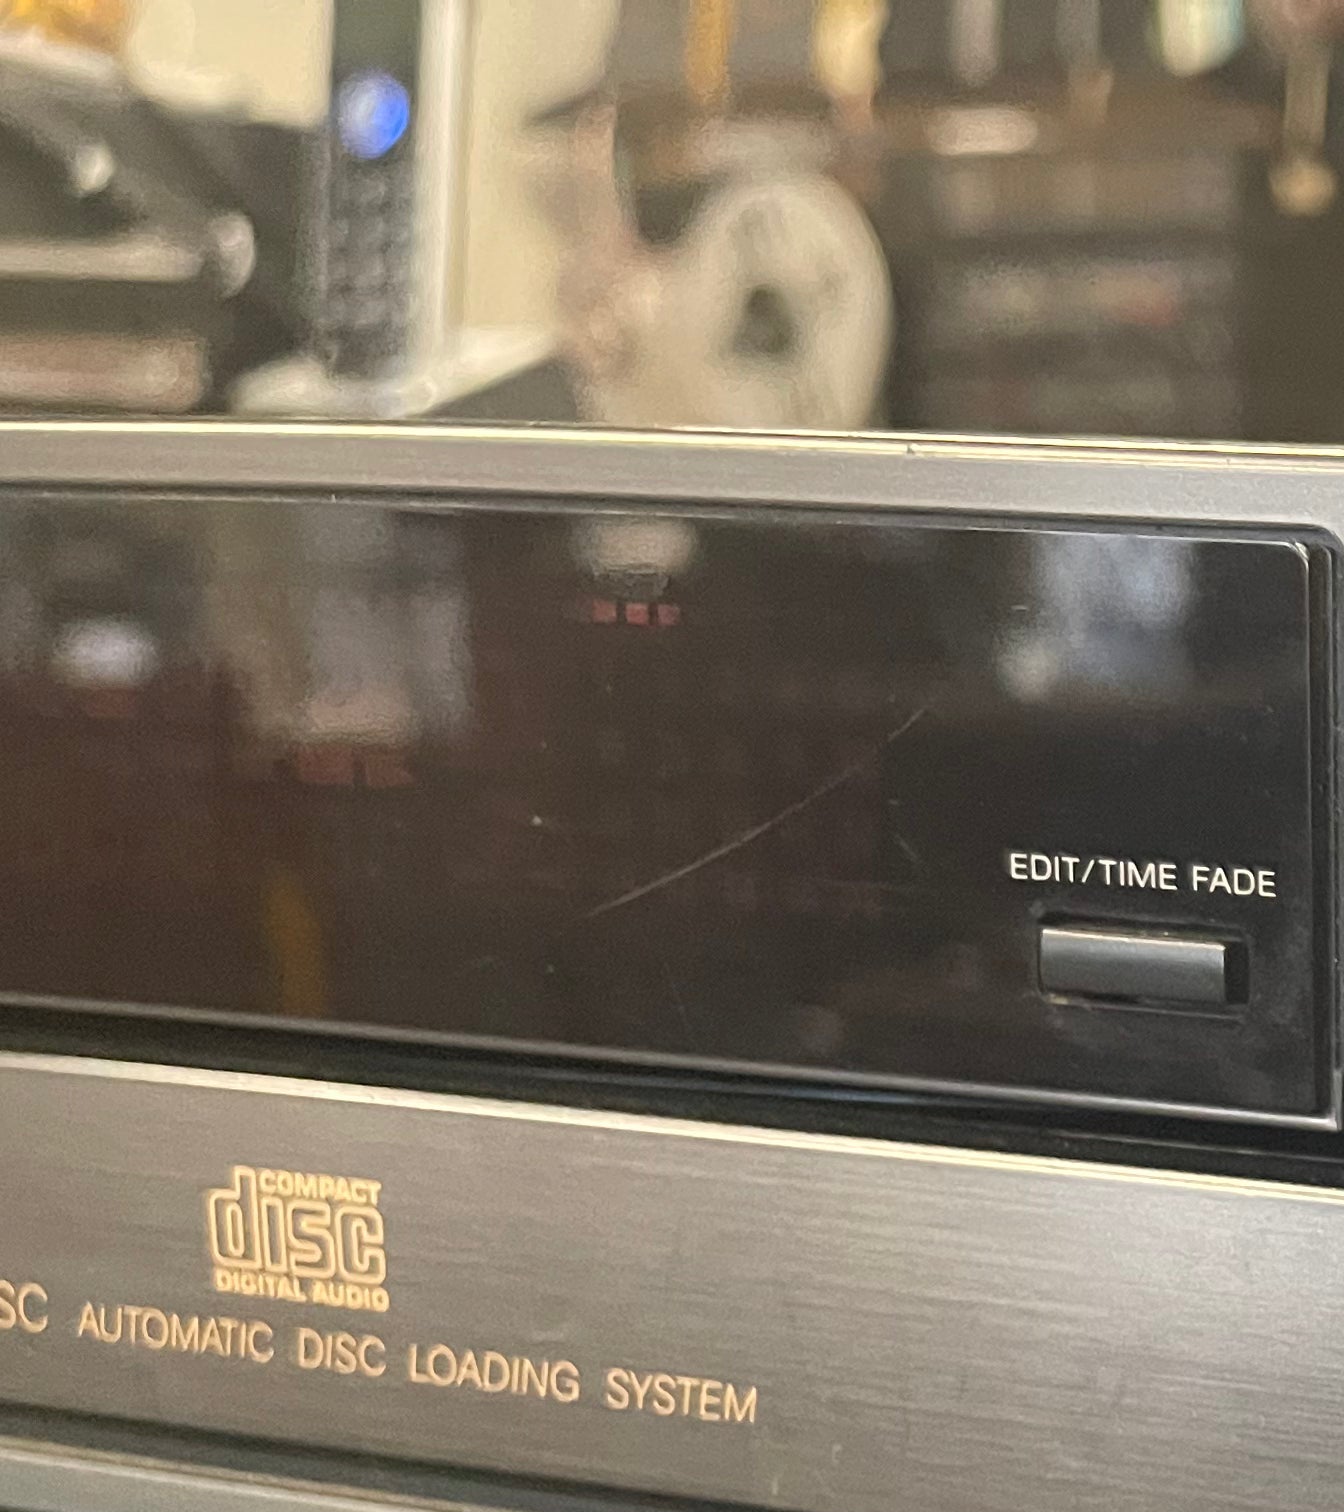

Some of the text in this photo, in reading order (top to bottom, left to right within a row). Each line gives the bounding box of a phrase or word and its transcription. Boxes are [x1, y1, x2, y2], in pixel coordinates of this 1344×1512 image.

[1009, 853, 1277, 897] EDIT/TIME FADE
[258, 1168, 382, 1206] COMPACT
[214, 1268, 390, 1313] DIGITAL AUDIO
[77, 1301, 275, 1364] AUTOMATIC
[296, 1326, 387, 1377] DISC
[407, 1343, 580, 1402] LOADING
[604, 1367, 758, 1423] SYSTEM
